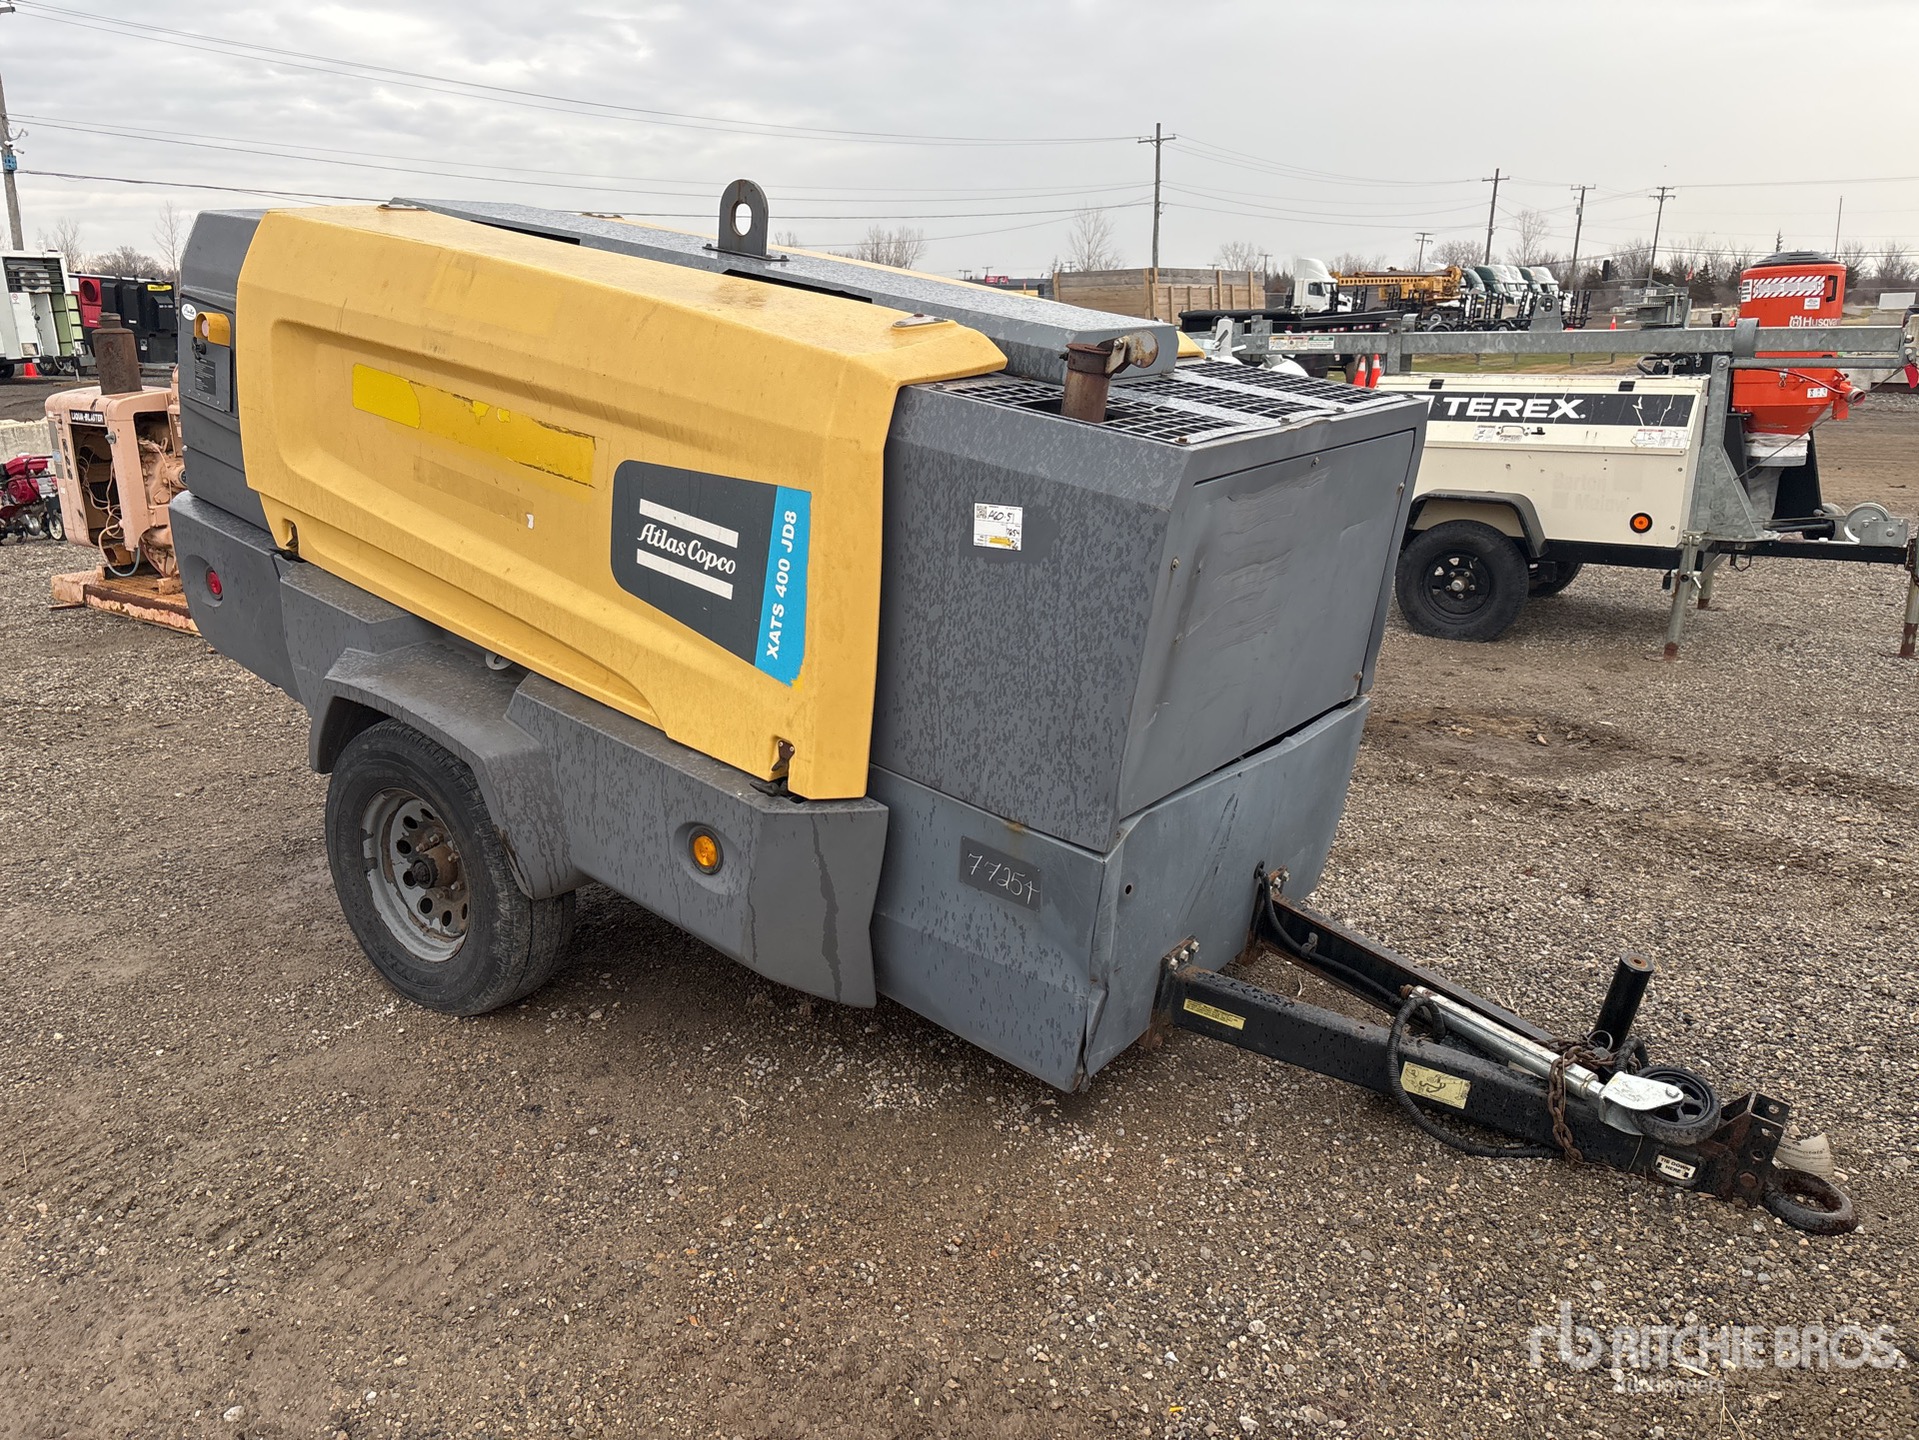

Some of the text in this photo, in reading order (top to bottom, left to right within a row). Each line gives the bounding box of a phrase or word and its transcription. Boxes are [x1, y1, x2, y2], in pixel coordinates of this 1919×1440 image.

[1443, 397, 1584, 419] TEREX
[637, 523, 736, 575] Atlas Copco
[766, 510, 797, 660] XATS 400 JD8
[968, 853, 1040, 904] 77254
[1665, 1164, 1682, 1174] HERE
[1670, 1161, 1691, 1172] DOWN
